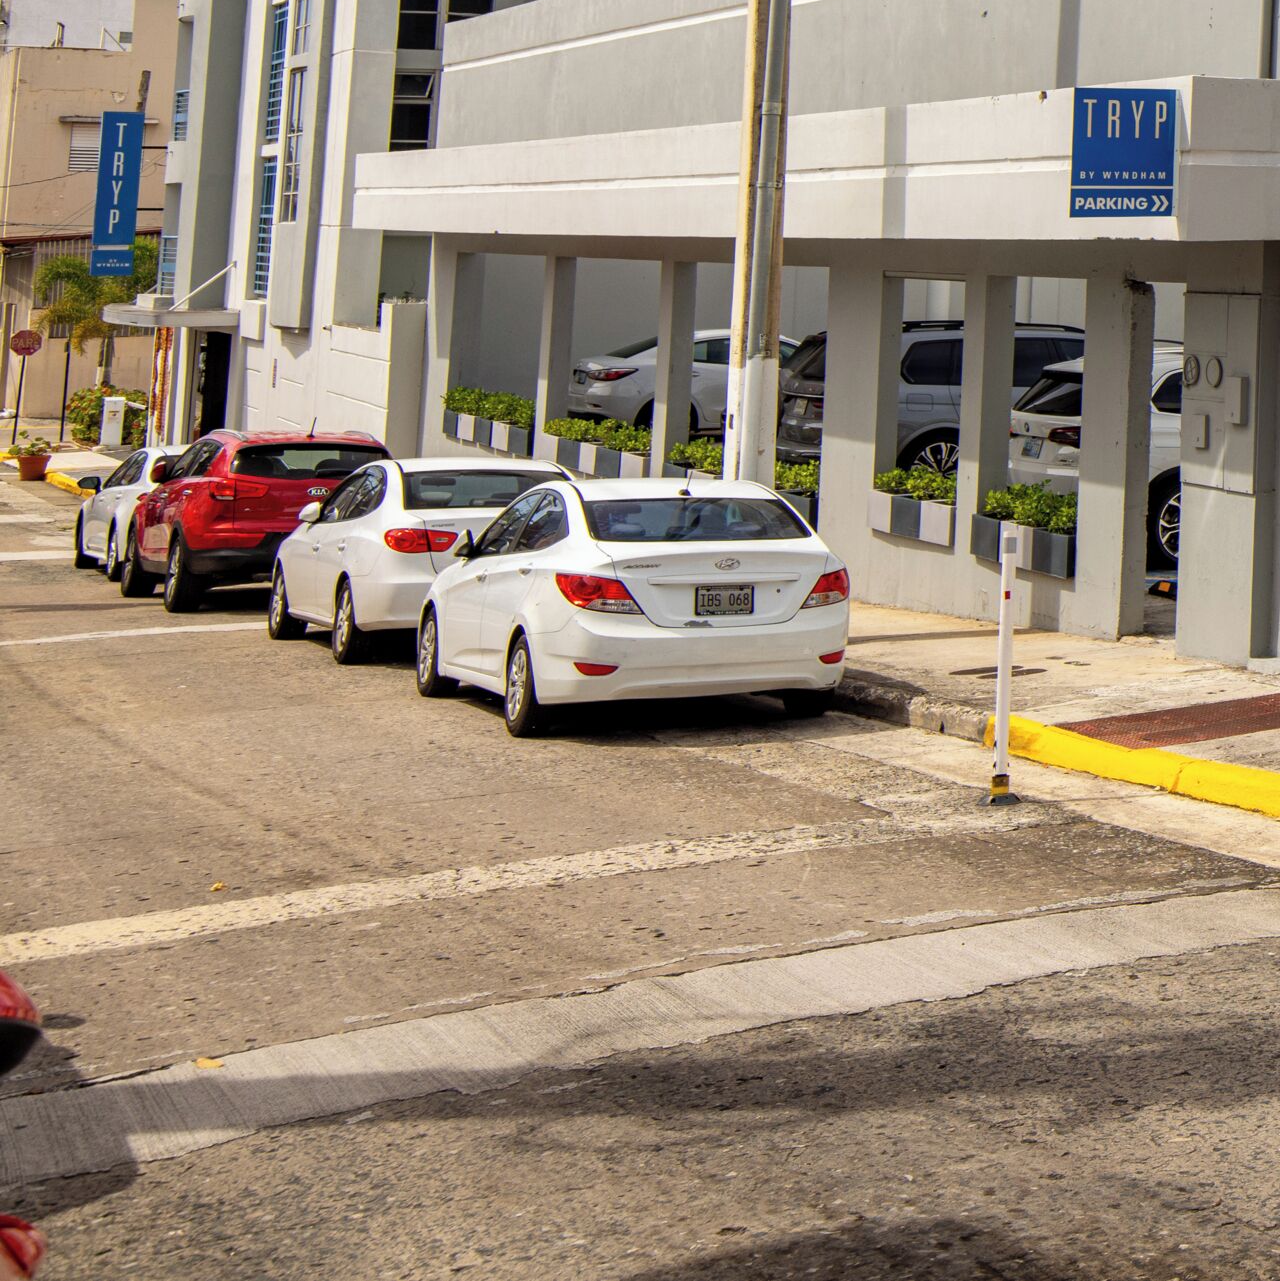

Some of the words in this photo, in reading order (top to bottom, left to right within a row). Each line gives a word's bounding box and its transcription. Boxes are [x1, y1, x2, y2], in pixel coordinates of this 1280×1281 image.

[1083, 99, 1167, 139] TRYP
[108, 122, 128, 234] TRYP
[1080, 171, 1095, 179] BY
[1102, 171, 1166, 180] WYNDHAM
[1075, 197, 1148, 210] PARKING
[700, 593, 721, 607] IBS
[728, 593, 750, 606] 068
